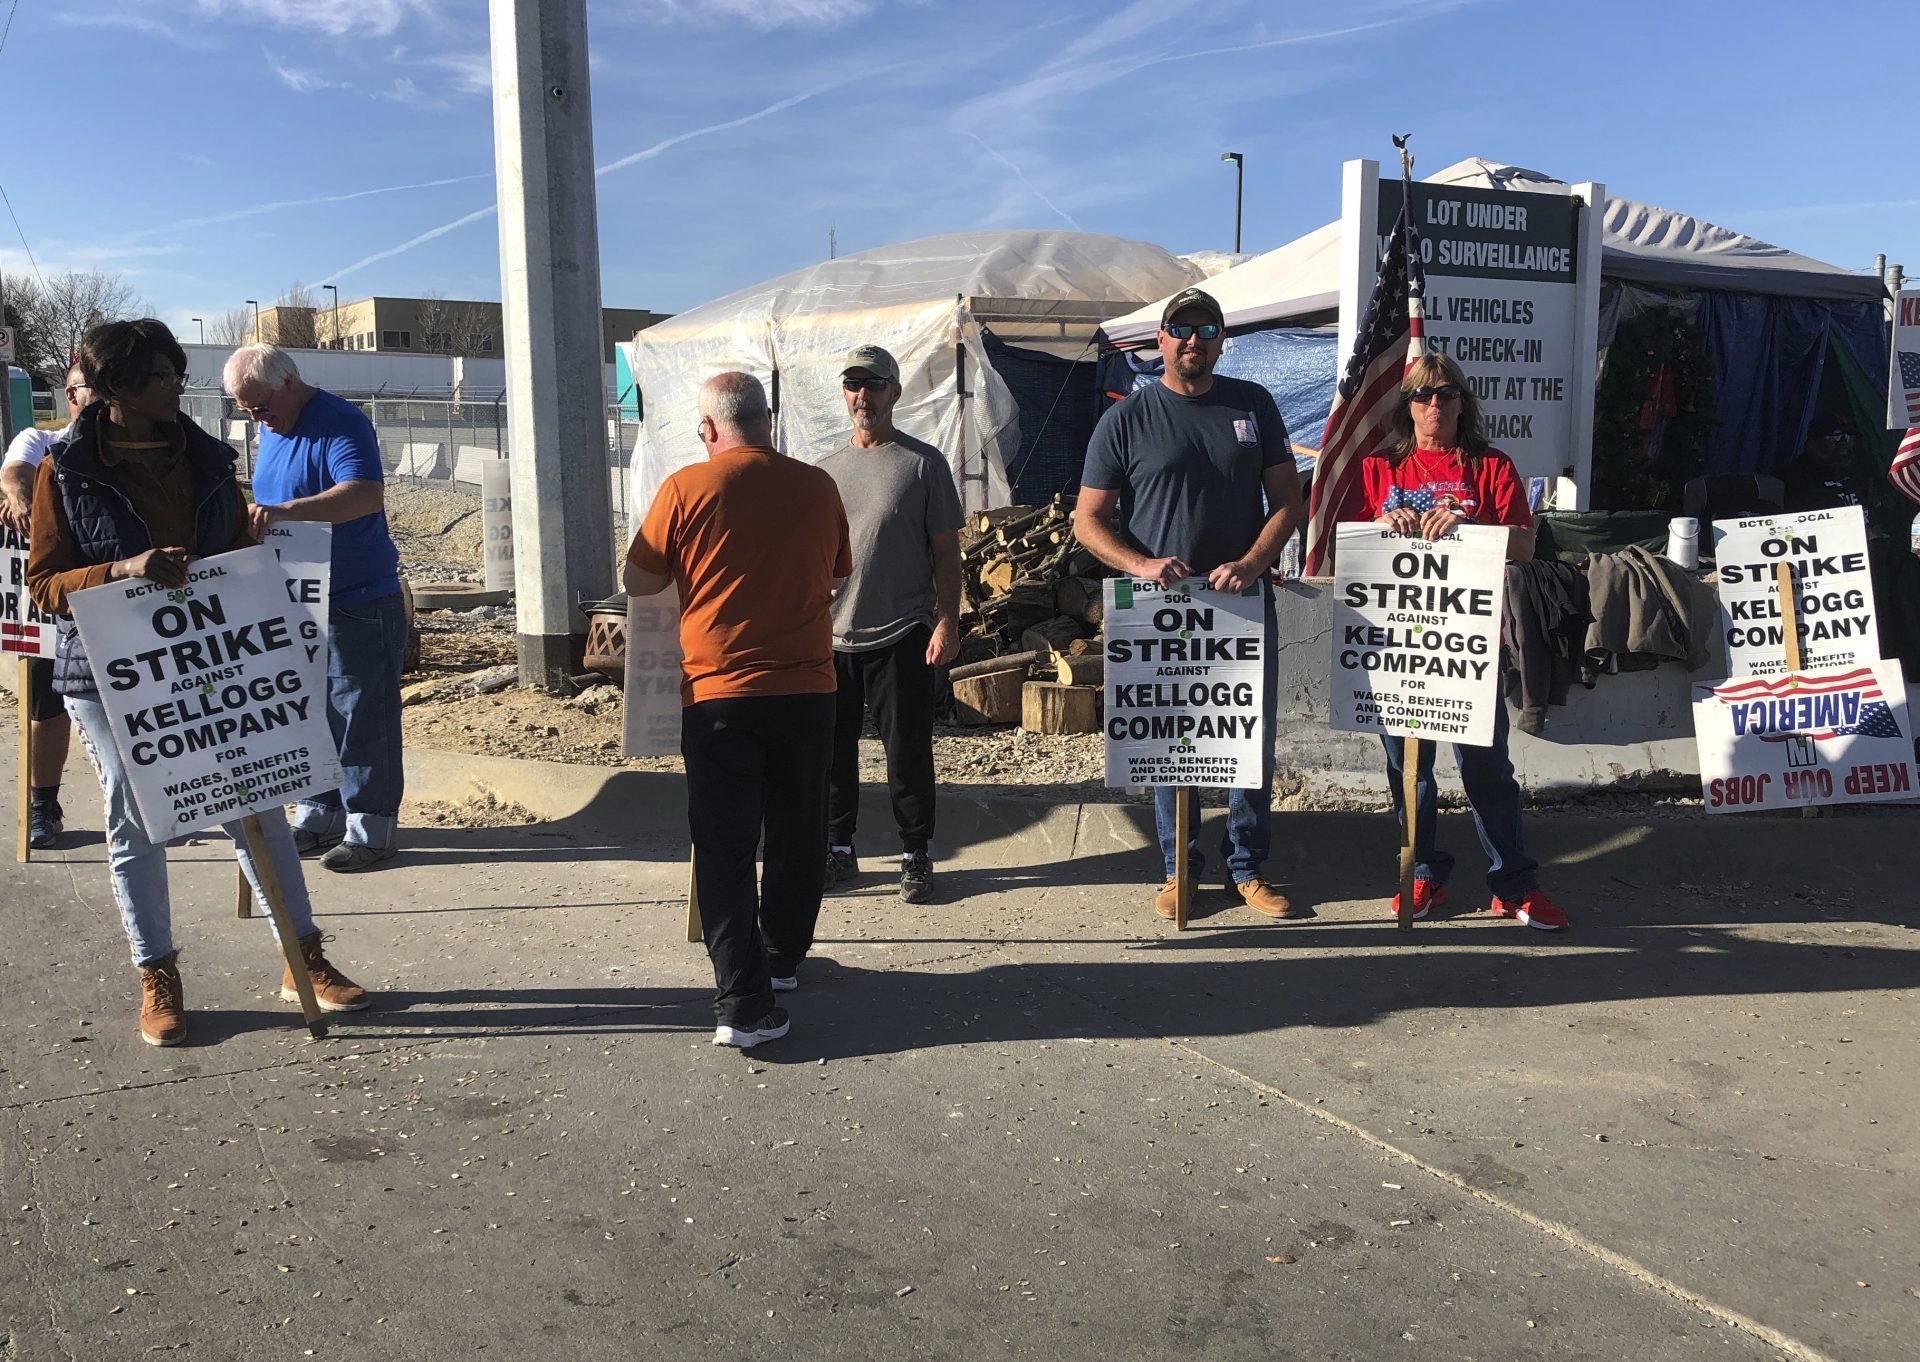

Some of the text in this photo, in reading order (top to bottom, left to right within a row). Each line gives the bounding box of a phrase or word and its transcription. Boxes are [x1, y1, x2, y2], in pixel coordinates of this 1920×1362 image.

[1427, 198, 1527, 232] LOT UNDER
[1438, 240, 1570, 272] SURVEILLANCE
[1423, 296, 1534, 324] LL VEHICLES
[1456, 336, 1542, 363] CHECK-IN
[1504, 377, 1529, 401] AT
[1530, 377, 1563, 401] THE
[1486, 415, 1533, 439] HACK
[1739, 513, 1834, 529] BCTG OCAL
[1411, 542, 1432, 550] 50G
[1760, 535, 1818, 558] ON
[1392, 552, 1449, 581] ON
[1720, 552, 1866, 584] STRIKE
[125, 566, 228, 599] BCTG OCAL
[1133, 583, 1170, 592] BCT
[1768, 581, 1820, 593] AINST
[1164, 594, 1191, 603] 50G
[1344, 582, 1493, 617] STRIKE
[1730, 590, 1865, 621] KELOGG
[152, 594, 226, 639] ON
[1153, 608, 1213, 632] ON
[1387, 612, 1448, 626] AGAINST
[1344, 625, 1488, 655] KELLOGG
[1726, 615, 1871, 648] COMPANY
[106, 616, 293, 692] STRIKE
[1107, 638, 1260, 663] STRIKE
[1156, 666, 1210, 676] AGAINST
[1340, 649, 1490, 681] COMPANY
[1749, 659, 1787, 668] WAGES
[1751, 667, 1776, 676] AND
[170, 664, 244, 694] AGAINST
[1400, 680, 1426, 690] FOR
[124, 669, 303, 737] KELLOGG
[1115, 683, 1253, 708] KELLOGG
[1353, 690, 1473, 710] WAGES, BENEFITS
[1355, 703, 1470, 723] AND CONDITIONS
[1355, 714, 1468, 734] OF EMPLOYMENT
[1730, 691, 1860, 736] AMERICA
[131, 696, 310, 766] COMPANY
[1107, 716, 1259, 740] COMPANY
[215, 746, 248, 763] FOR
[1128, 757, 1238, 766] WAGES, BENEFITS
[1168, 746, 1196, 754] FOR
[1786, 736, 1817, 767] IN
[163, 746, 310, 797] WAGES, BENEFITS
[1130, 766, 1236, 774] AND CONDITIONS
[1131, 775, 1236, 783] OF EMPLOYMENT
[173, 761, 311, 811] AND CONDITIONS
[1709, 762, 1911, 807] KEEP OUR JOBS
[177, 775, 312, 823] OF EMPLOYMENT
